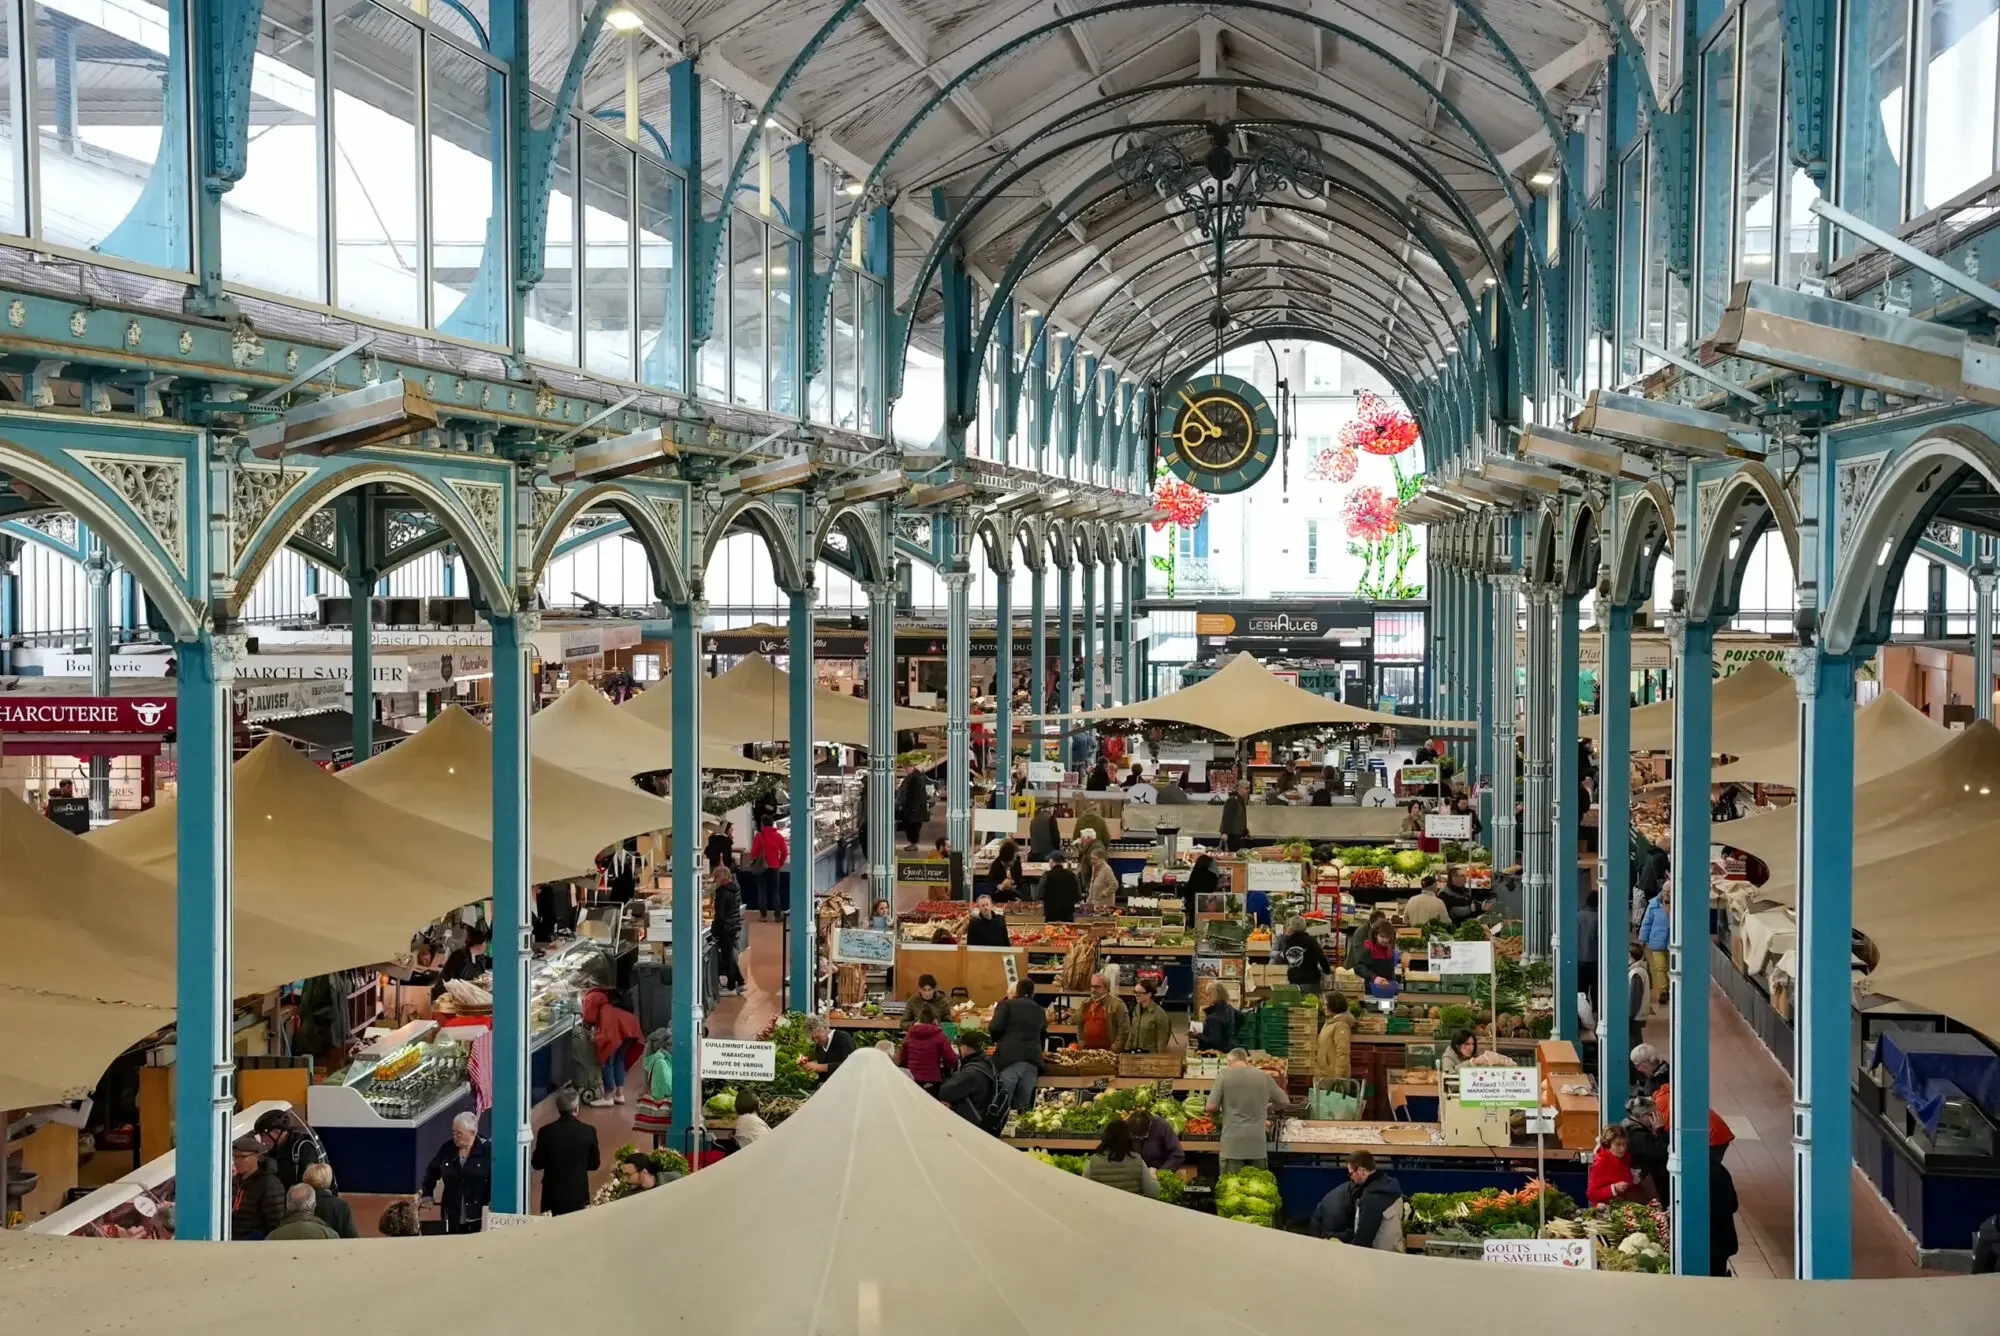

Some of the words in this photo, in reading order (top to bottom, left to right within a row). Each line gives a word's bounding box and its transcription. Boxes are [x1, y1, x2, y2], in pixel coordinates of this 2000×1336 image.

[418, 634, 445, 646] Du
[313, 666, 403, 682] SABIER
[0, 705, 119, 722] HARCUTERIE
[1503, 1253, 1559, 1263] SAVEURS
